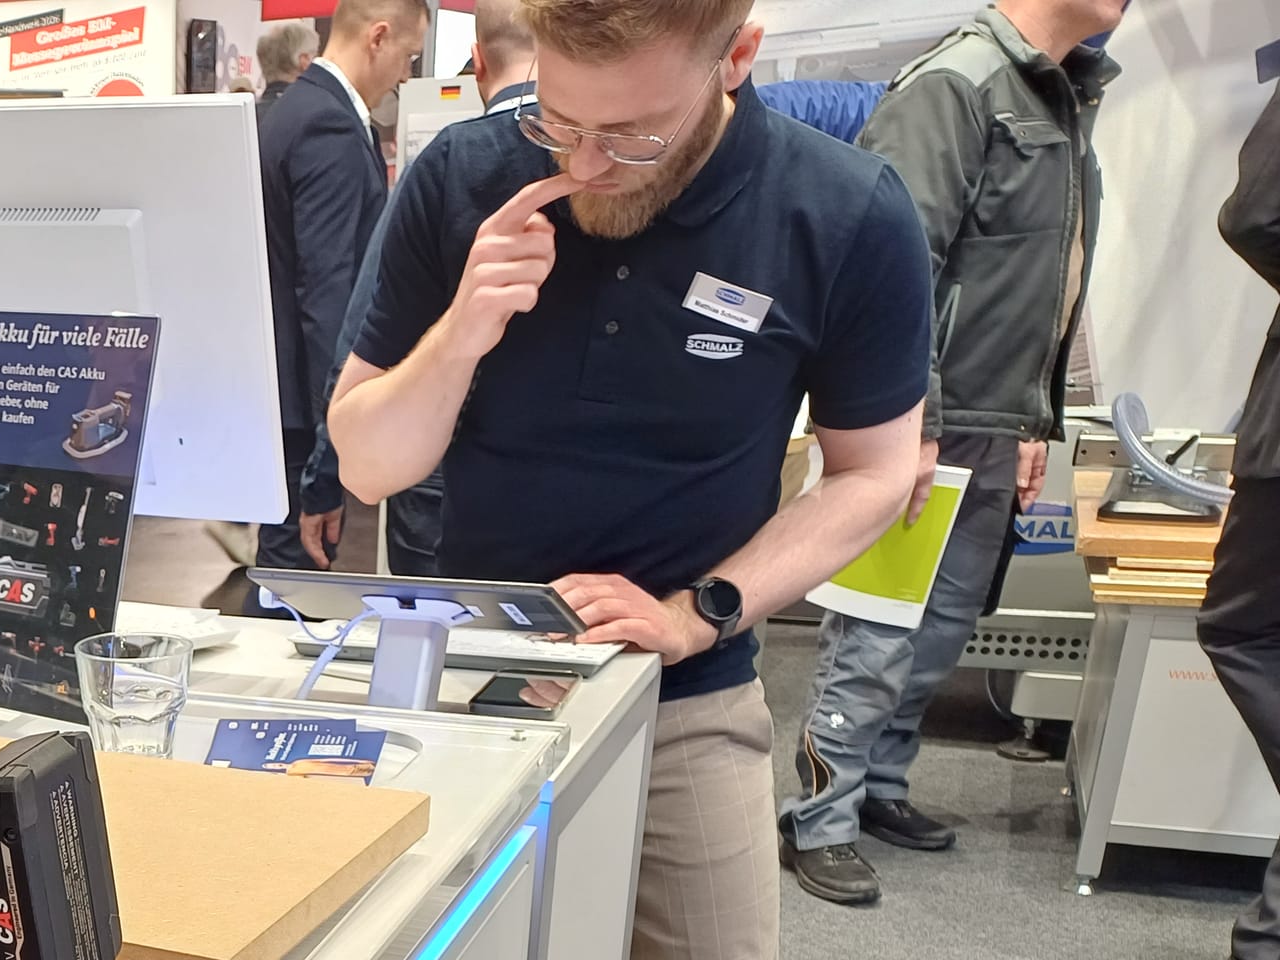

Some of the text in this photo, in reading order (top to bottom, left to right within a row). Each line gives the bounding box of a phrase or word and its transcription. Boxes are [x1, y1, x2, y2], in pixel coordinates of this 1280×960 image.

[27, 324, 60, 349] für
[62, 326, 101, 347] viele
[103, 327, 150, 349] Fälle
[686, 339, 745, 352] SCHMALZ
[1, 362, 35, 377] einfach
[37, 364, 56, 378] den
[57, 366, 77, 379] CAS
[78, 367, 106, 381] Akku
[6, 379, 43, 393] Geräten
[44, 382, 60, 395] für
[24, 397, 49, 410] ohne
[2, 409, 34, 424] kaufen
[66, 788, 79, 838] WARNING
[53, 800, 69, 870] ADVERTENCIA
[61, 794, 78, 874] AVERTISSEMENT
